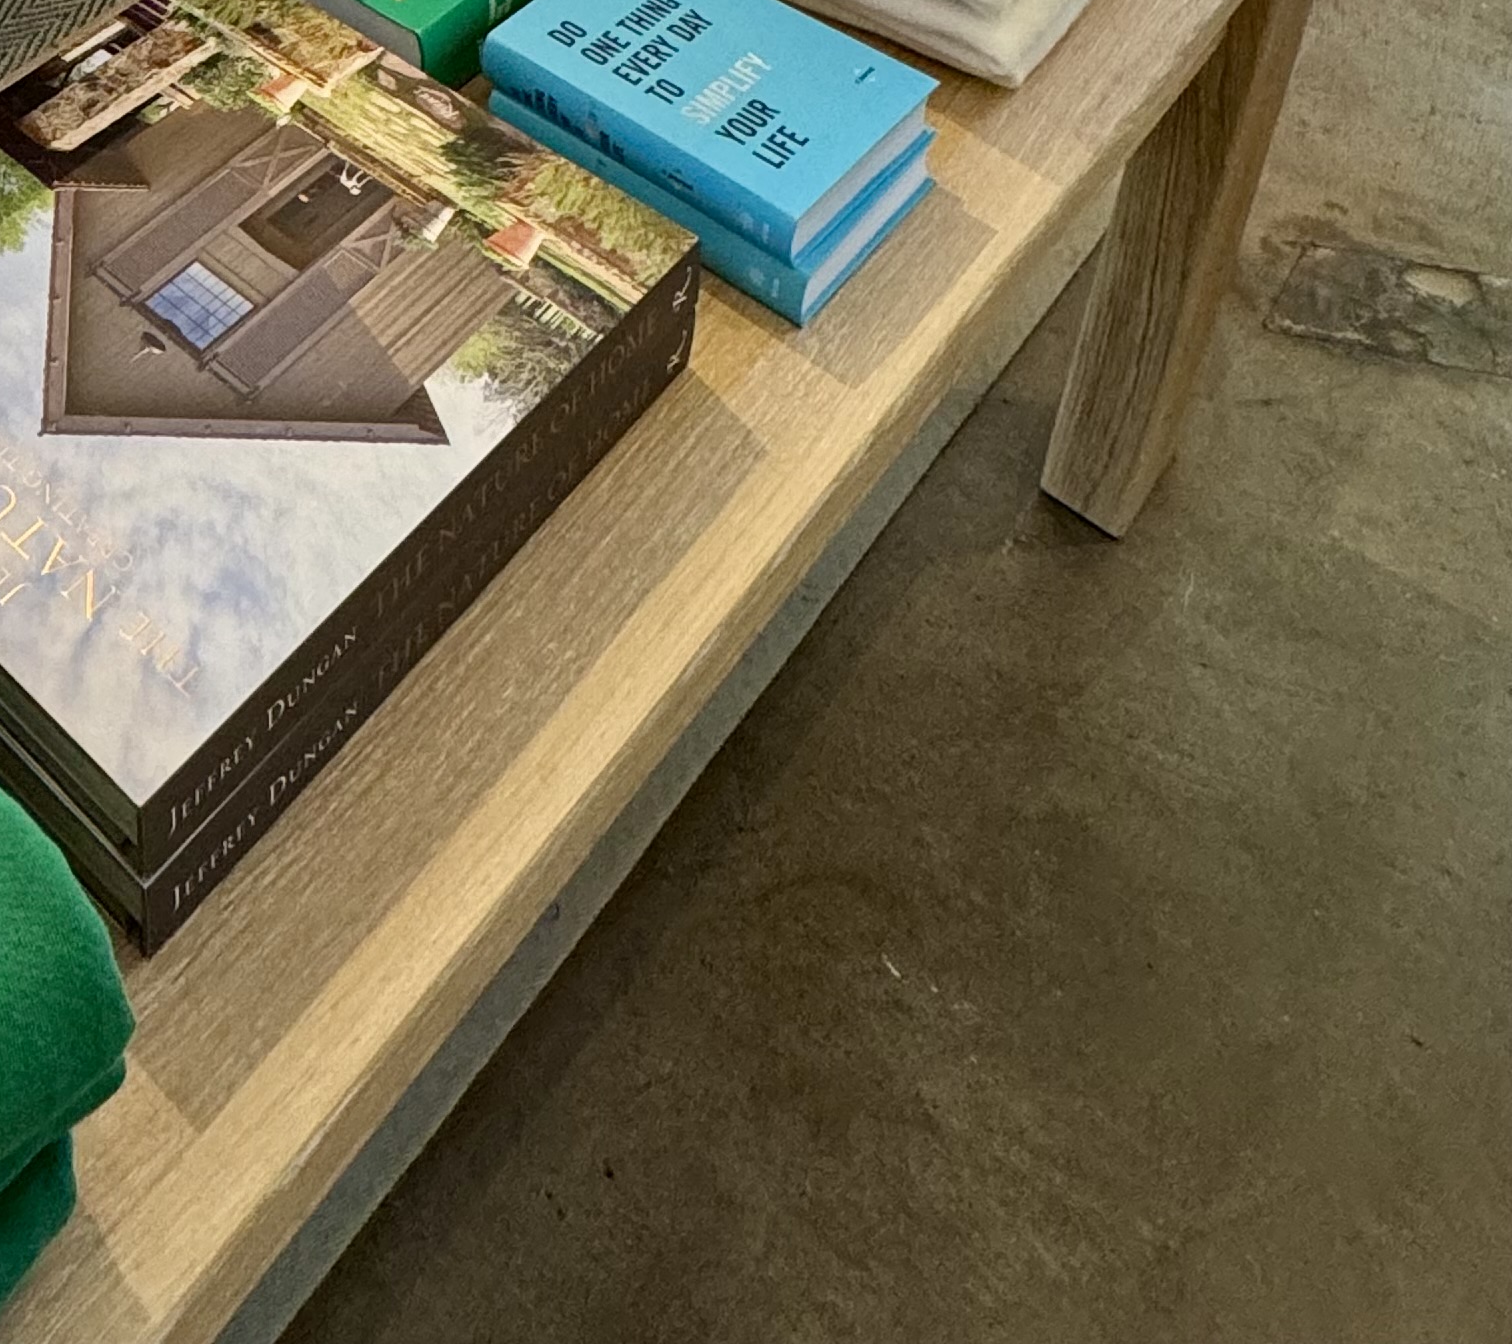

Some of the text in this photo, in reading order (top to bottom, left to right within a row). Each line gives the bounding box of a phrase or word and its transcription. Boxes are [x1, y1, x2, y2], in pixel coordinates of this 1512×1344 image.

[546, 19, 588, 49] DO
[580, 29, 633, 67] ONE
[612, 8, 714, 87] EVERY DAY
[644, 77, 686, 106] TO
[680, 50, 773, 128] SIMPLIFY
[713, 98, 782, 148] YOUR
[751, 127, 812, 170] LIFE
[118, 611, 204, 698] THE
[167, 734, 255, 833] JEFFREY
[266, 624, 359, 731] DUNGAN
[172, 811, 258, 913] JEFFREY
[268, 698, 359, 809] DUNGAN
